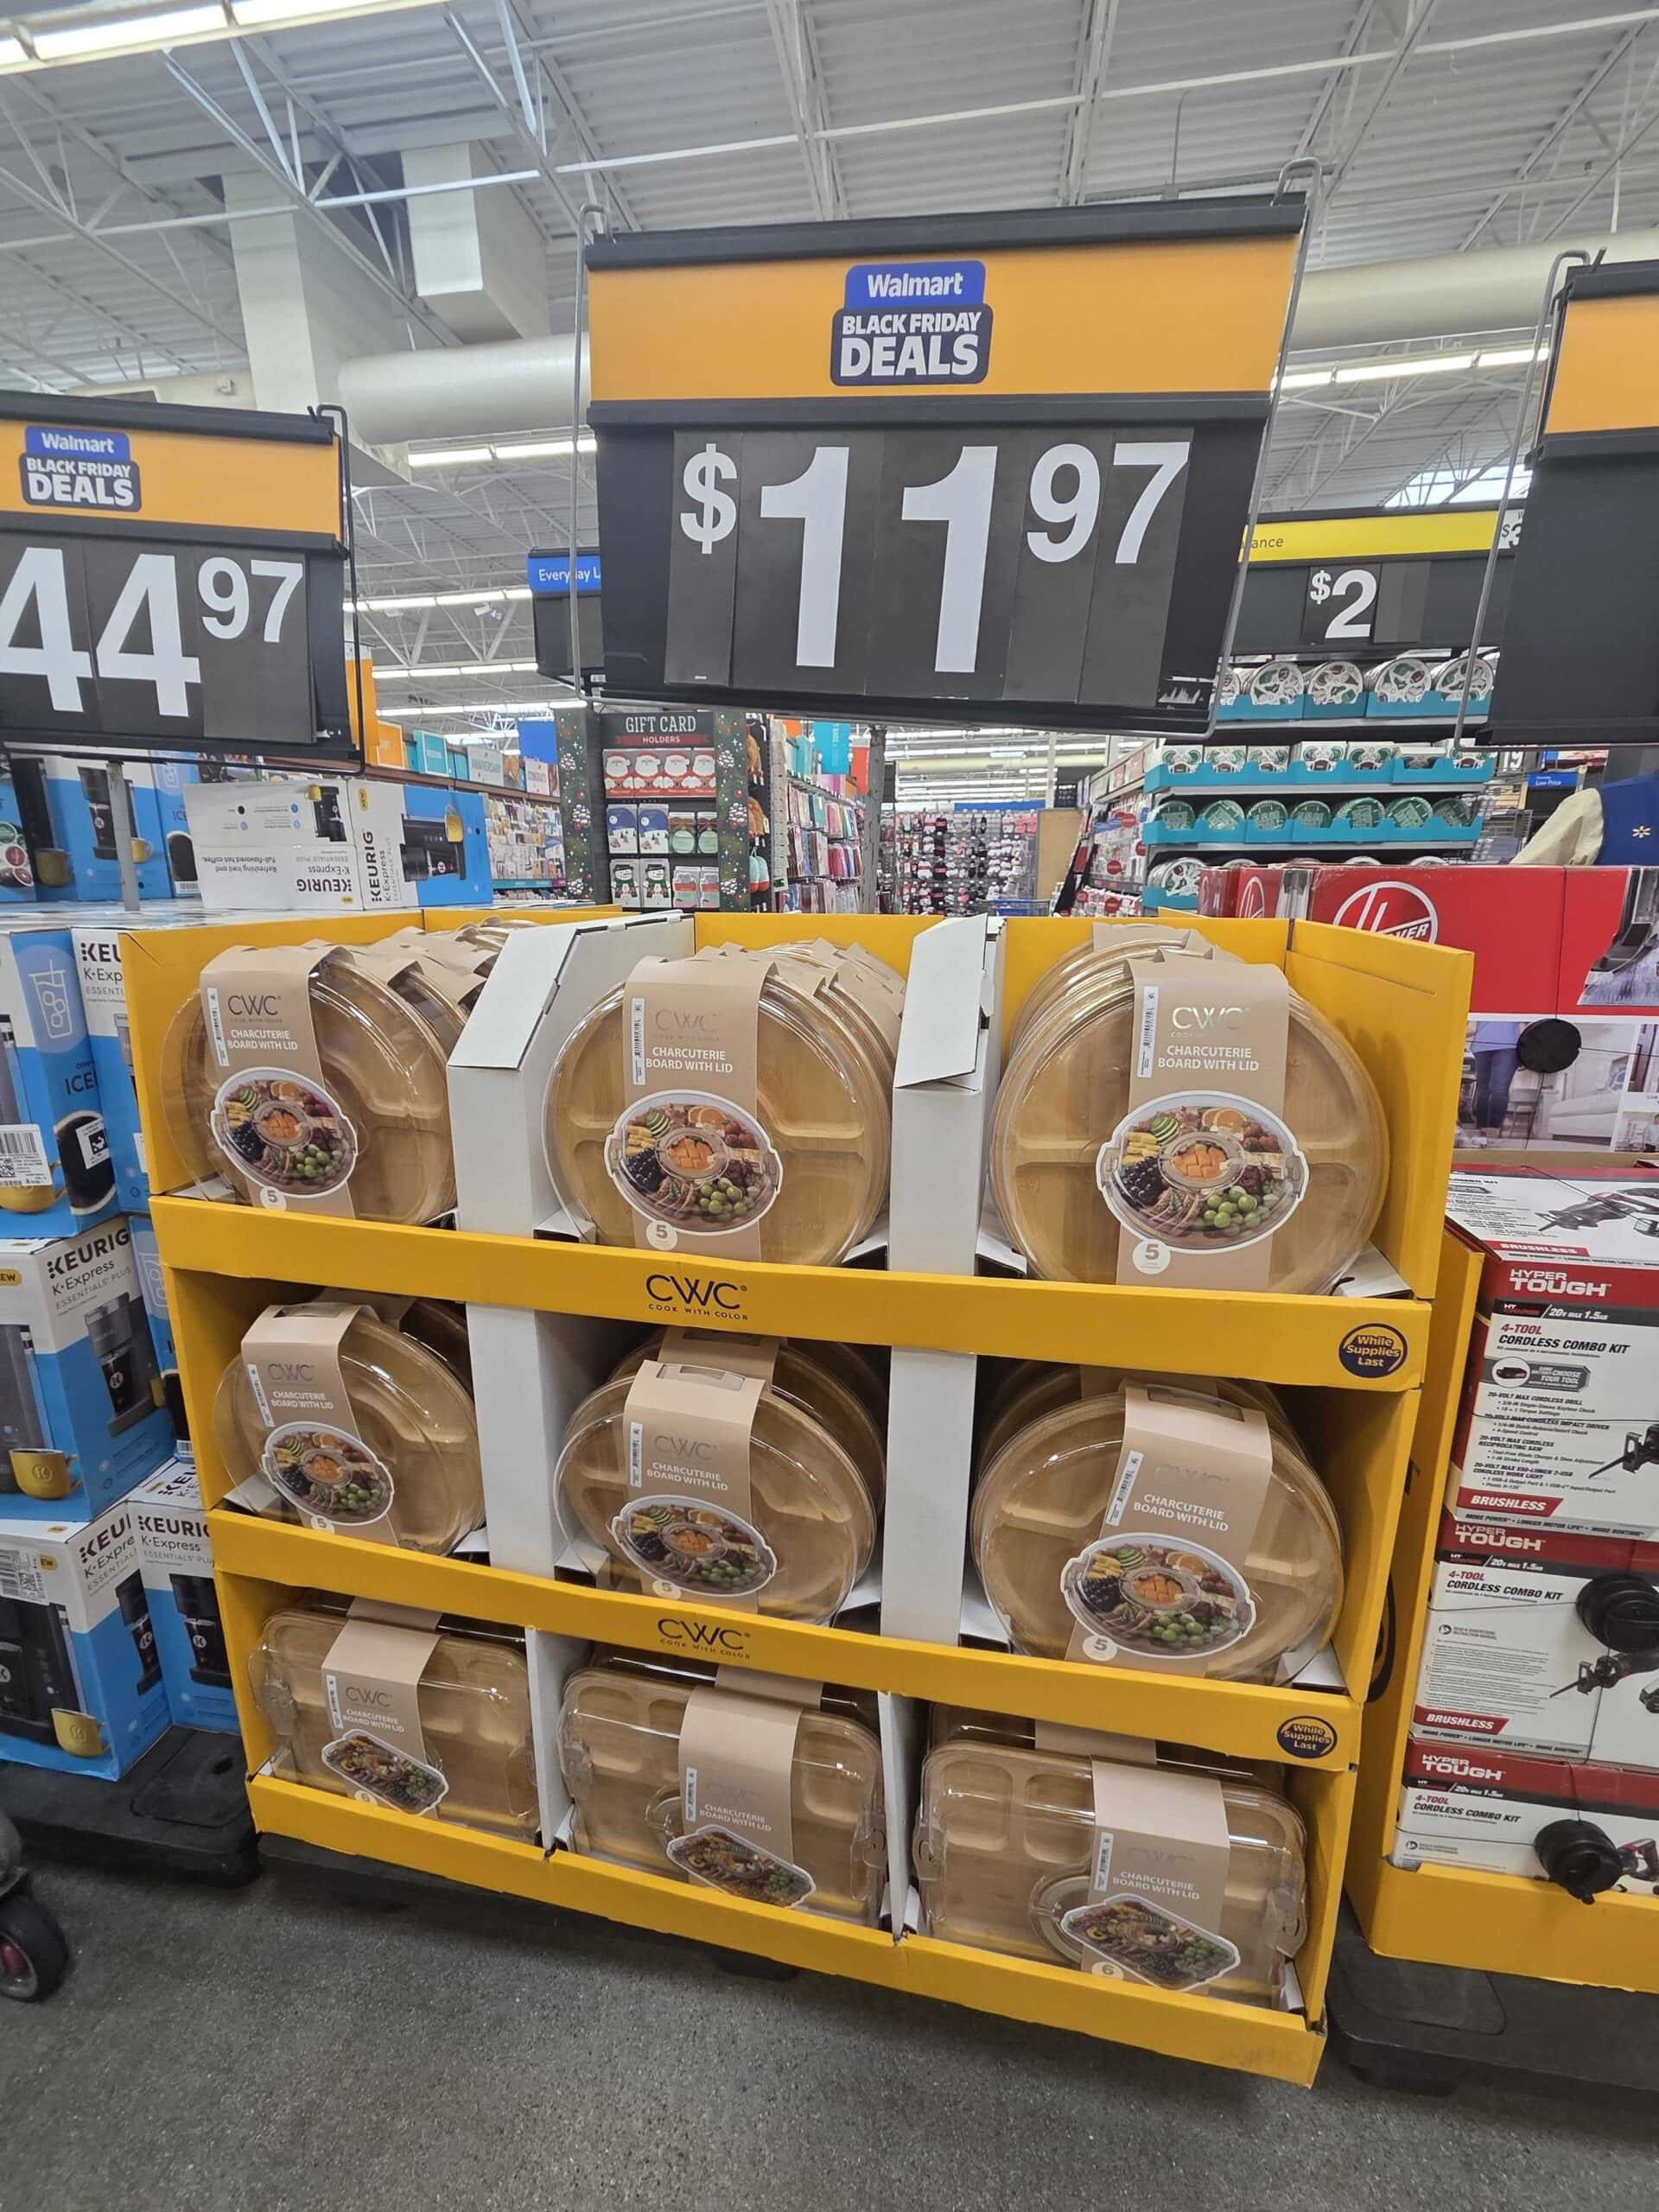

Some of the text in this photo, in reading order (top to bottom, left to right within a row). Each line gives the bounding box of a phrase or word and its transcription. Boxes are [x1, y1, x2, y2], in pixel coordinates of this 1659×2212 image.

[868, 272, 963, 298] Walmart
[842, 312, 982, 335] BLACK FRIDAY
[840, 334, 979, 377] DEALS
[41, 432, 115, 454] Walmart
[27, 456, 131, 480] BLACK FRIDAY
[29, 477, 134, 507] DEALS
[539, 568, 590, 584] Everyay
[626, 715, 696, 733] GIFT CARD
[244, 864, 277, 874] Refreshing
[363, 830, 383, 903] KEURIG
[296, 879, 353, 893] KEURIG
[228, 995, 280, 1015] CWC
[1172, 1007, 1243, 1030] CWC
[231, 1029, 290, 1039] CHARCUTERIE
[227, 1039, 298, 1051] BOARD WITH LID
[652, 1046, 727, 1061] CHARCUTERIE
[1166, 1045, 1252, 1058] CHARCUTERIE
[645, 1058, 734, 1073] BOARD WITH LID
[1158, 1058, 1259, 1071] BOARD WITH LID
[267, 1190, 278, 1204] 5
[656, 1225, 668, 1239] 5
[47, 1228, 129, 1280] KEURIG
[1145, 1243, 1160, 1261] 5
[1500, 1243, 1580, 1255] BRUSHLESS
[1510, 1268, 1567, 1281] HYPER
[646, 1274, 743, 1310] CWC
[1510, 1277, 1608, 1297] TOUGH
[648, 1303, 748, 1320] COOK WITH COLOR
[1501, 1323, 1542, 1335] 4-TOOL
[1357, 1335, 1393, 1347] While
[1498, 1334, 1560, 1349] CORDLESS
[1562, 1339, 1607, 1352] COMBO
[1609, 1343, 1630, 1354] KIT
[1346, 1344, 1400, 1357] Supplies
[1357, 1357, 1384, 1367] Last
[268, 1363, 314, 1382] CWC
[270, 1399, 298, 1408] BOARD
[298, 1401, 320, 1409] WITH
[273, 1390, 326, 1401] CHARCUTERIE
[655, 1435, 712, 1460] CWC
[646, 1469, 728, 1491] BOARD WITH LID
[652, 1462, 721, 1481] CHARCUTERIE
[1144, 1494, 1224, 1520] CHARCUTERIE
[1471, 1496, 1547, 1511] BRUSHLESS
[1134, 1502, 1229, 1531] BOARD WITH LID
[1455, 1523, 1506, 1535] HYPER
[1455, 1531, 1541, 1551] TOUGH
[1448, 1570, 1485, 1581] 4-TOOL
[1446, 1580, 1501, 1593] CORDLESS
[1503, 1586, 1542, 1599] COMBO
[1544, 1591, 1563, 1600] KIT
[658, 1618, 745, 1649] CWC
[692, 1643, 715, 1653] WITH
[721, 1649, 750, 1659] COLOR
[1094, 1639, 1109, 1652] 5
[346, 1687, 391, 1707] CWC
[371, 1720, 391, 1730] WITH
[1427, 1713, 1494, 1729] BRUSHLESS
[1284, 1730, 1331, 1744] Supplies
[1293, 1724, 1325, 1736] While
[1294, 1740, 1317, 1751] Last
[1422, 1754, 1469, 1765] HYPER
[1422, 1760, 1503, 1781] TOUGH
[1415, 1795, 1449, 1805] 4-TOOL
[700, 1809, 730, 1822] BOARD
[732, 1818, 755, 1828] WITH
[705, 1803, 765, 1823] CHARCUTERIE
[1414, 1802, 1464, 1815] CORDLESS
[1465, 1809, 1502, 1820] COMBO
[1503, 1814, 1521, 1822] KIT
[1113, 1877, 1199, 1899] BOARD WITH LID
[1121, 1872, 1194, 1891] CHARCUTERIE
